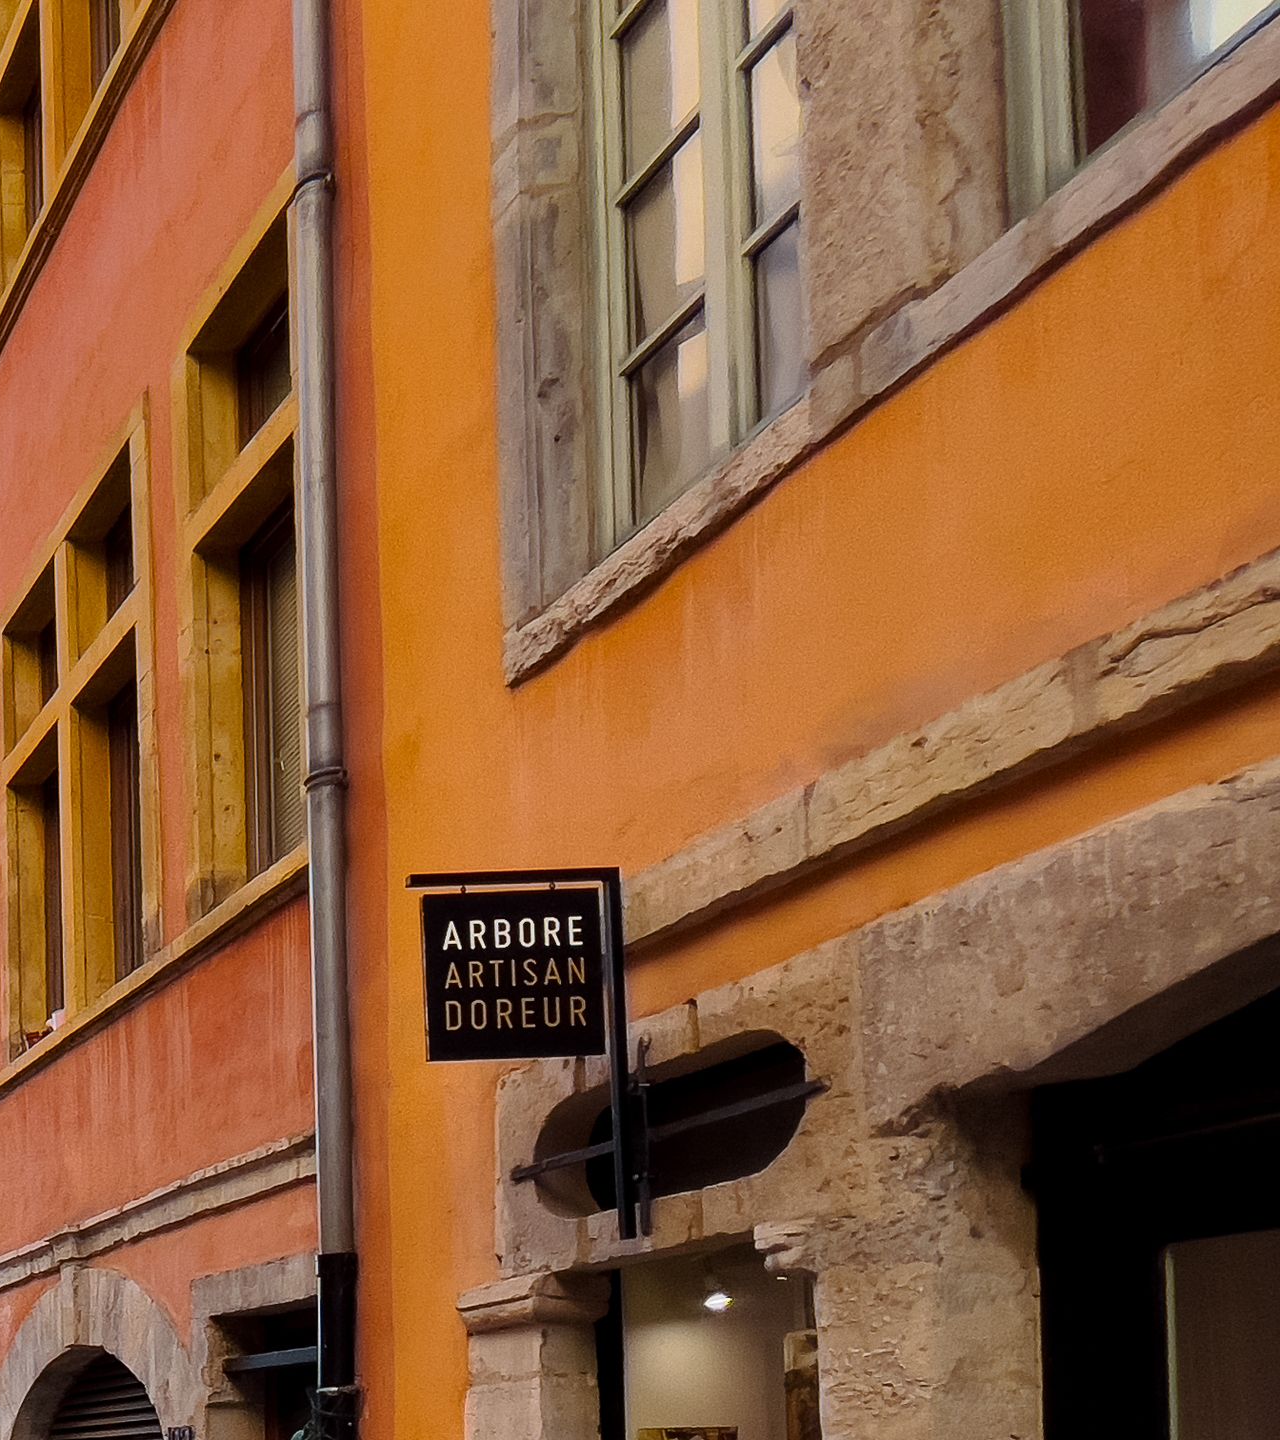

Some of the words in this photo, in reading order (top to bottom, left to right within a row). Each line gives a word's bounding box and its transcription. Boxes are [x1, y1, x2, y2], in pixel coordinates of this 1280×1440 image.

[442, 915, 584, 951] ARBORE
[444, 956, 587, 990] ARTISAN
[444, 995, 588, 1031] DOREUR
